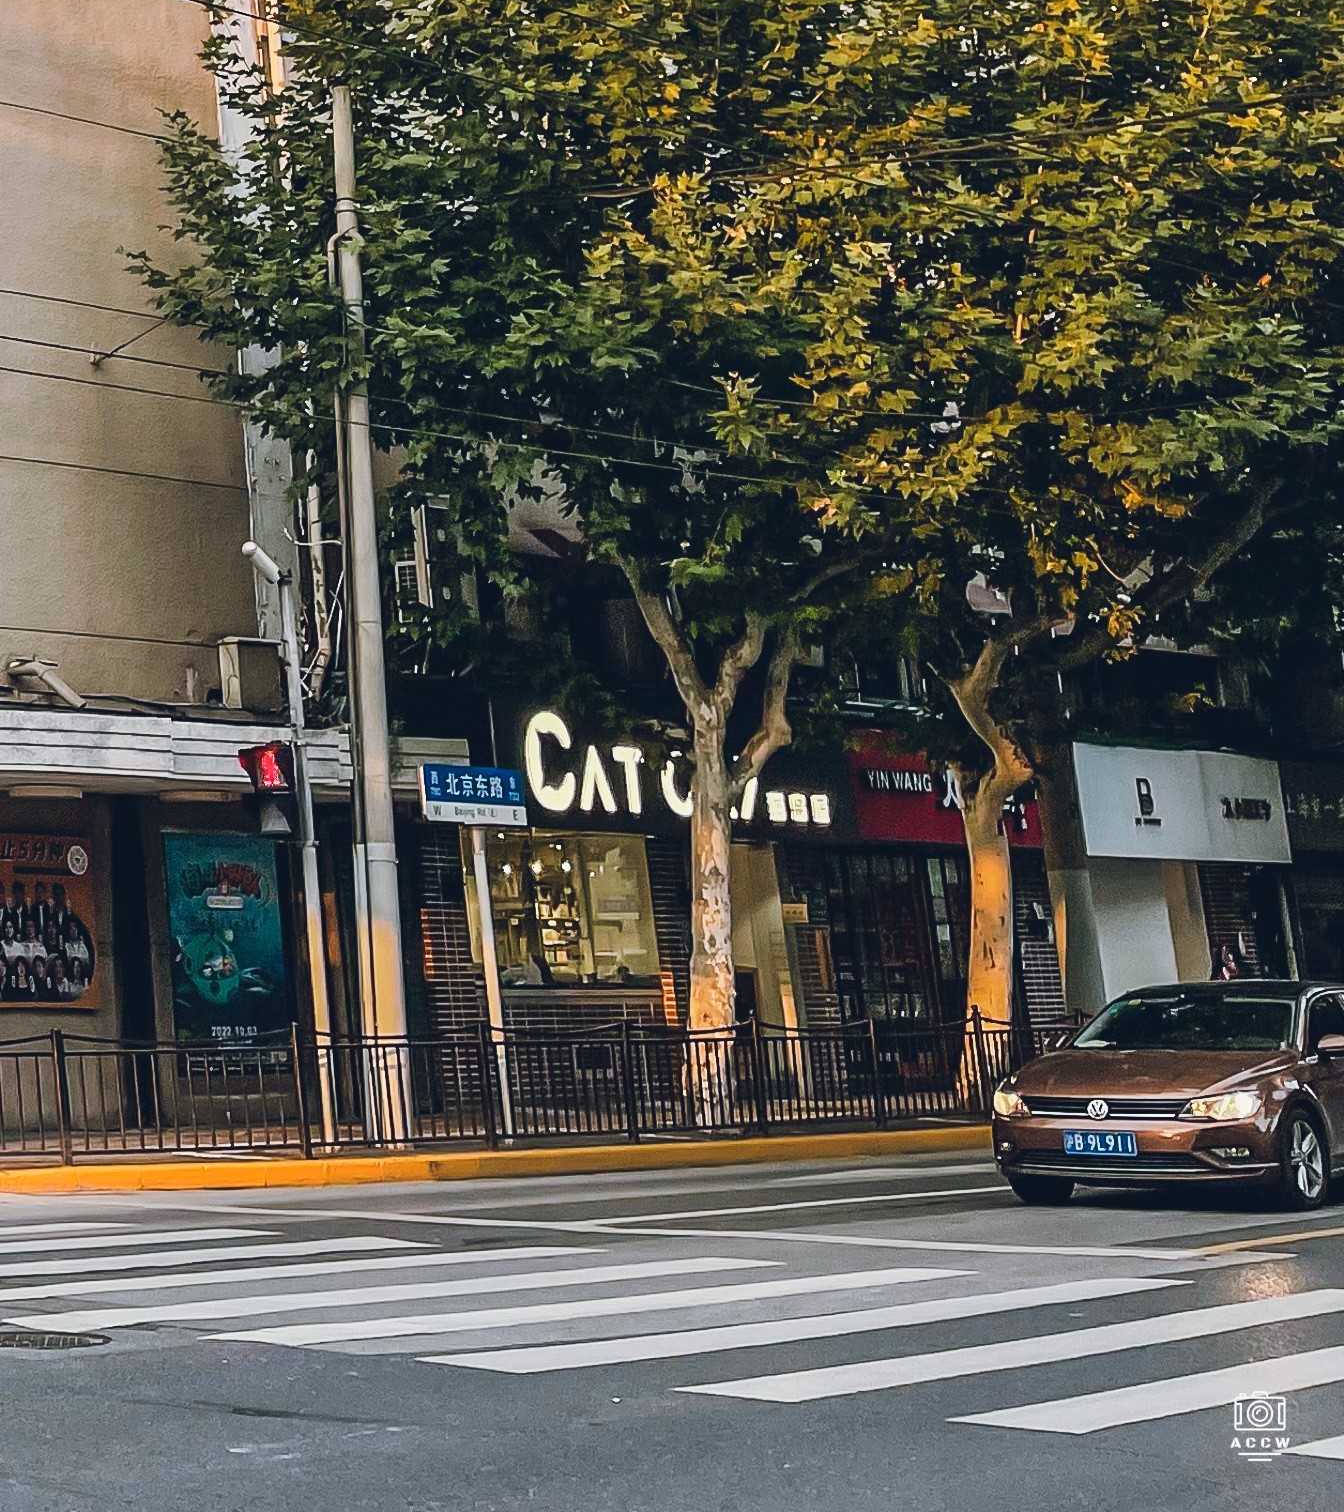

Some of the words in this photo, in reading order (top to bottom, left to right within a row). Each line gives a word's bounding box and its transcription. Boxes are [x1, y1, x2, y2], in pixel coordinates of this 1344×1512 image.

[445, 773, 503, 798] 北京东路
[867, 770, 890, 790] YIN
[893, 771, 932, 793] WANG
